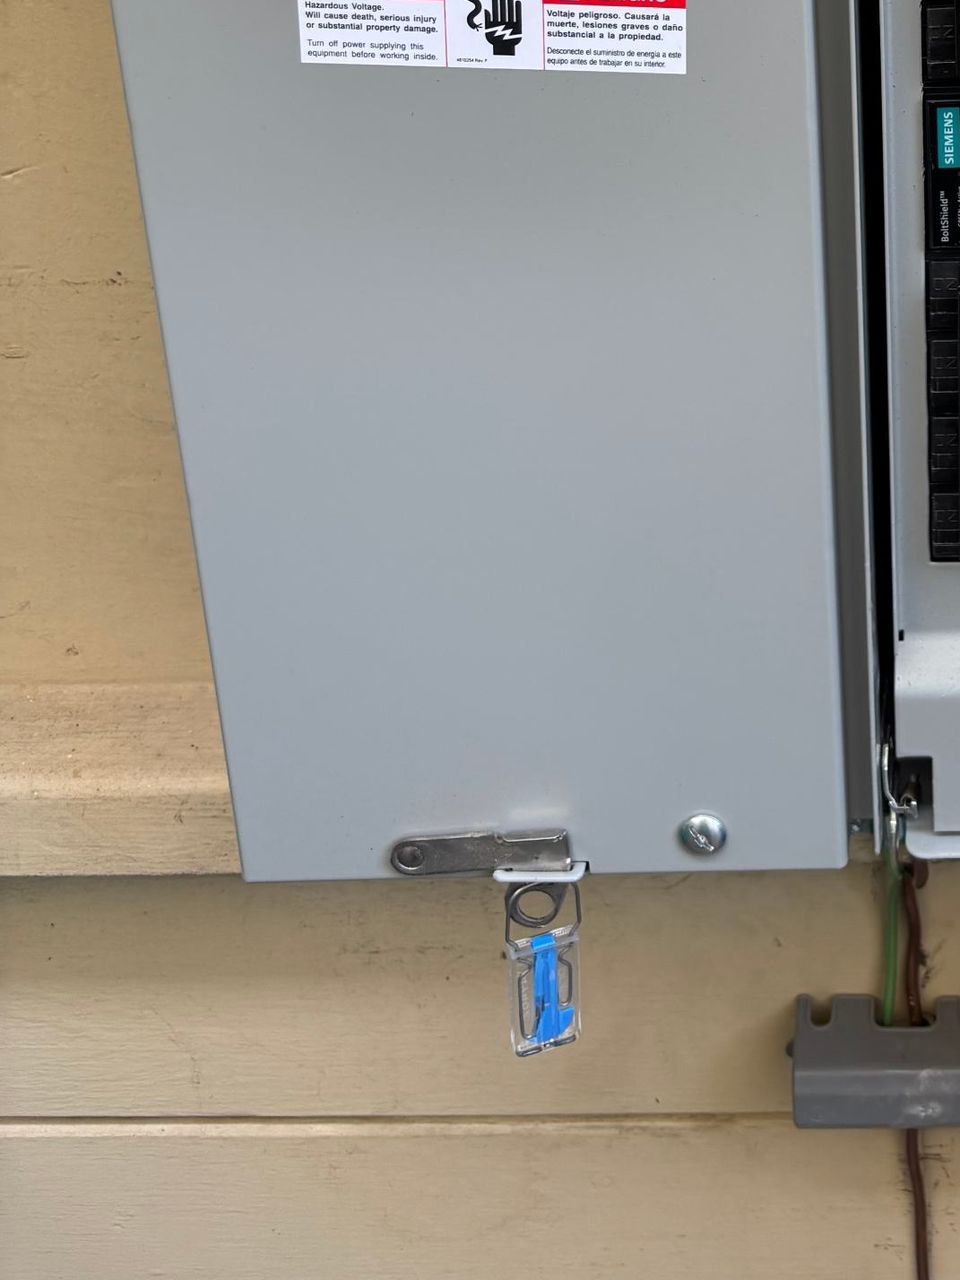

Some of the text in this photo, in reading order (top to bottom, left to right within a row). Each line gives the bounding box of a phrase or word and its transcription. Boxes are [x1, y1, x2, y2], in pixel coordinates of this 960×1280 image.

[305, 1, 385, 13] Hazardous Voltage.
[306, 12, 437, 25] Will cause death, serious injury
[547, 10, 576, 21] Voltaje
[579, 11, 621, 23] peligroso.
[624, 12, 659, 21] Causará
[306, 21, 438, 34] or substantial property damage.
[547, 19, 578, 30] muerte,
[582, 20, 618, 29] lesiones
[621, 22, 650, 32] graves
[662, 22, 683, 31] daño
[547, 30, 596, 39] substancial
[619, 32, 664, 41] propiedad.
[308, 39, 424, 52] Turn off power supplying this
[546, 46, 584, 55] Desconecte
[586, 47, 592, 55] el
[594, 48, 625, 57] suministro
[627, 49, 636, 57] de
[308, 49, 438, 61] equipment before working inside.
[547, 56, 568, 65] equipo
[570, 57, 588, 65] antes
[589, 57, 598, 65] de
[599, 58, 623, 68] trabajar
[944, 111, 954, 164] SIEMENS
